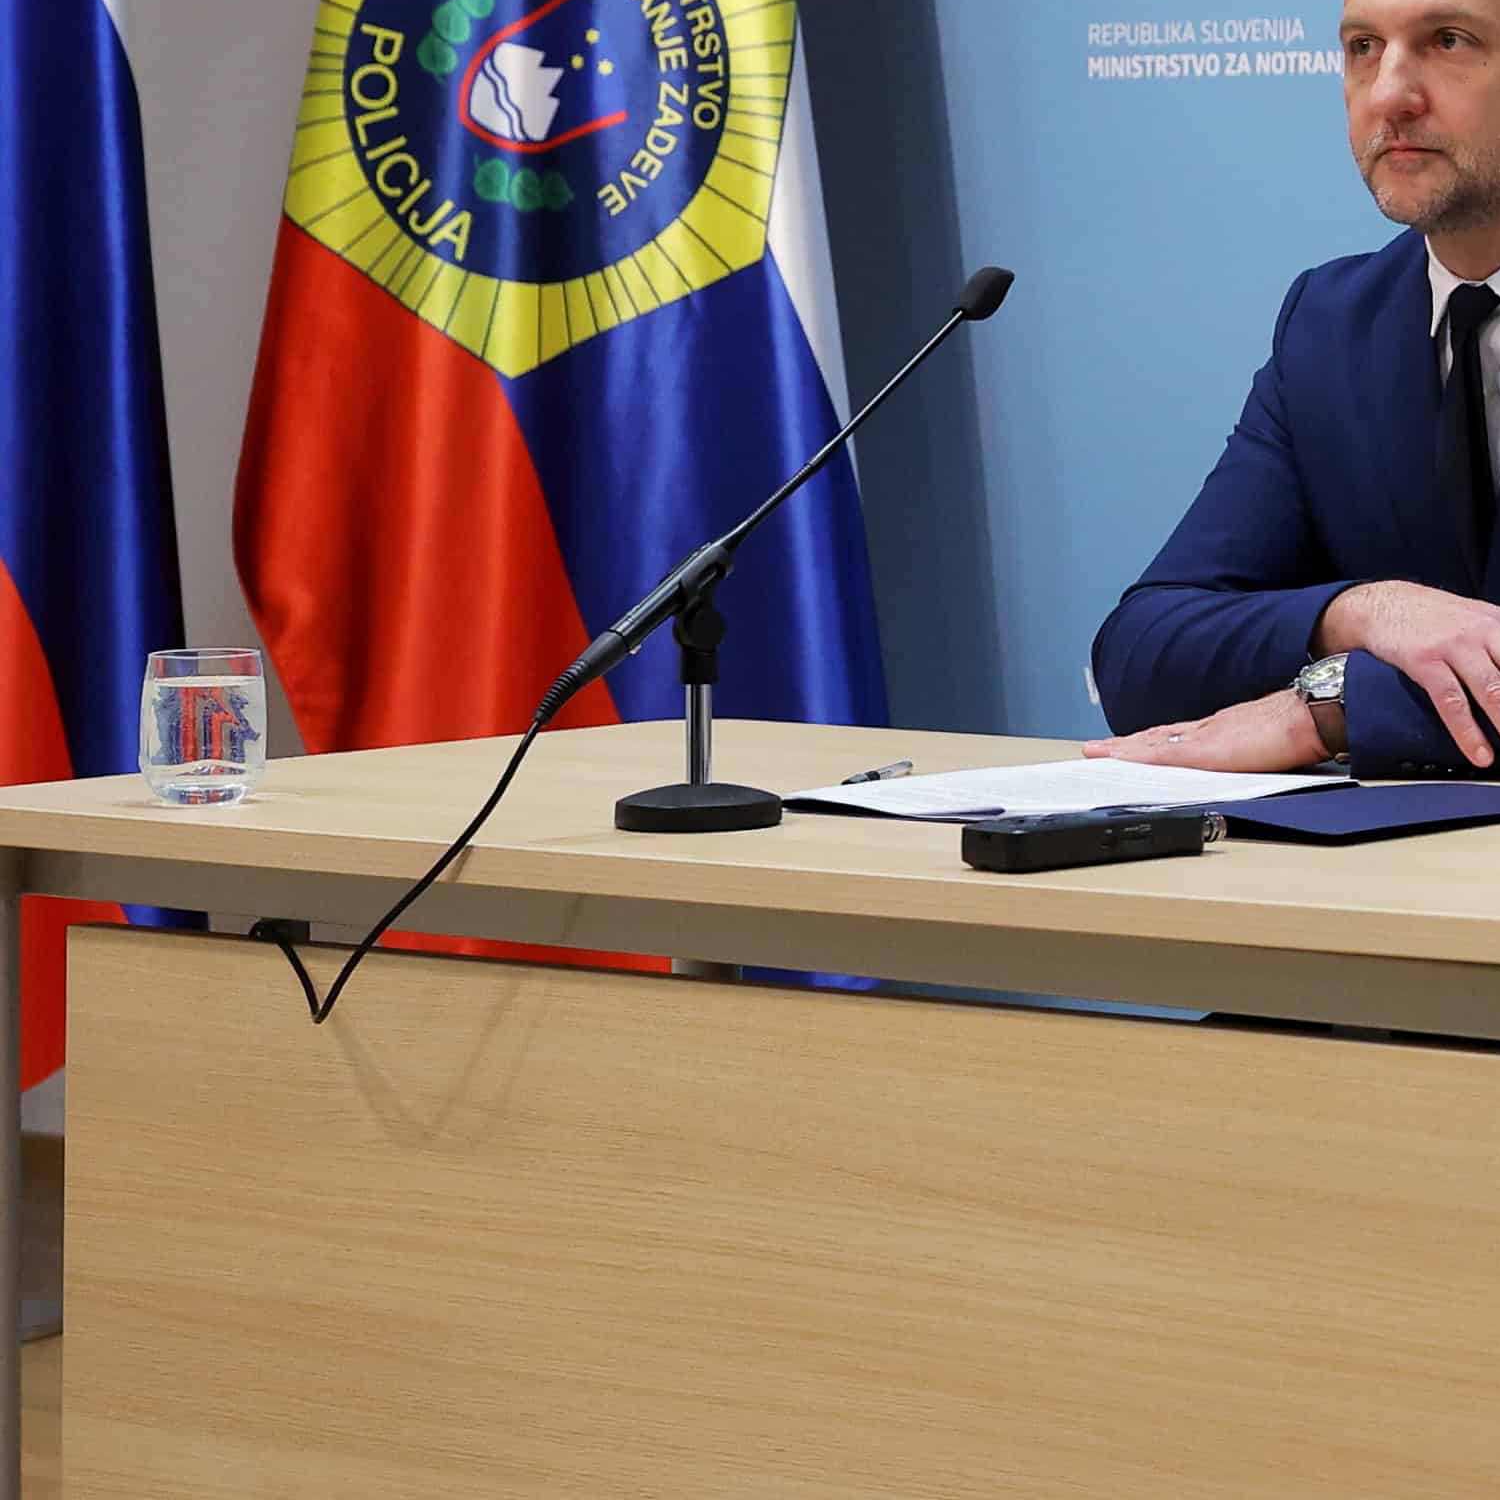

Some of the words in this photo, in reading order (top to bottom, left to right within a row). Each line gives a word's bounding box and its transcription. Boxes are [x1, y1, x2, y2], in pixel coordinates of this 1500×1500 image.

[1087, 52, 1221, 79] MINISTRSTVO
[1224, 51, 1252, 77] ZA
[1255, 49, 1346, 76] NOTRAN
[1088, 20, 1196, 47] REPUBLIKA
[1200, 17, 1305, 45] SLOVENIJA
[350, 23, 472, 262] POLICIJA
[596, 81, 690, 217] ZADEVE
